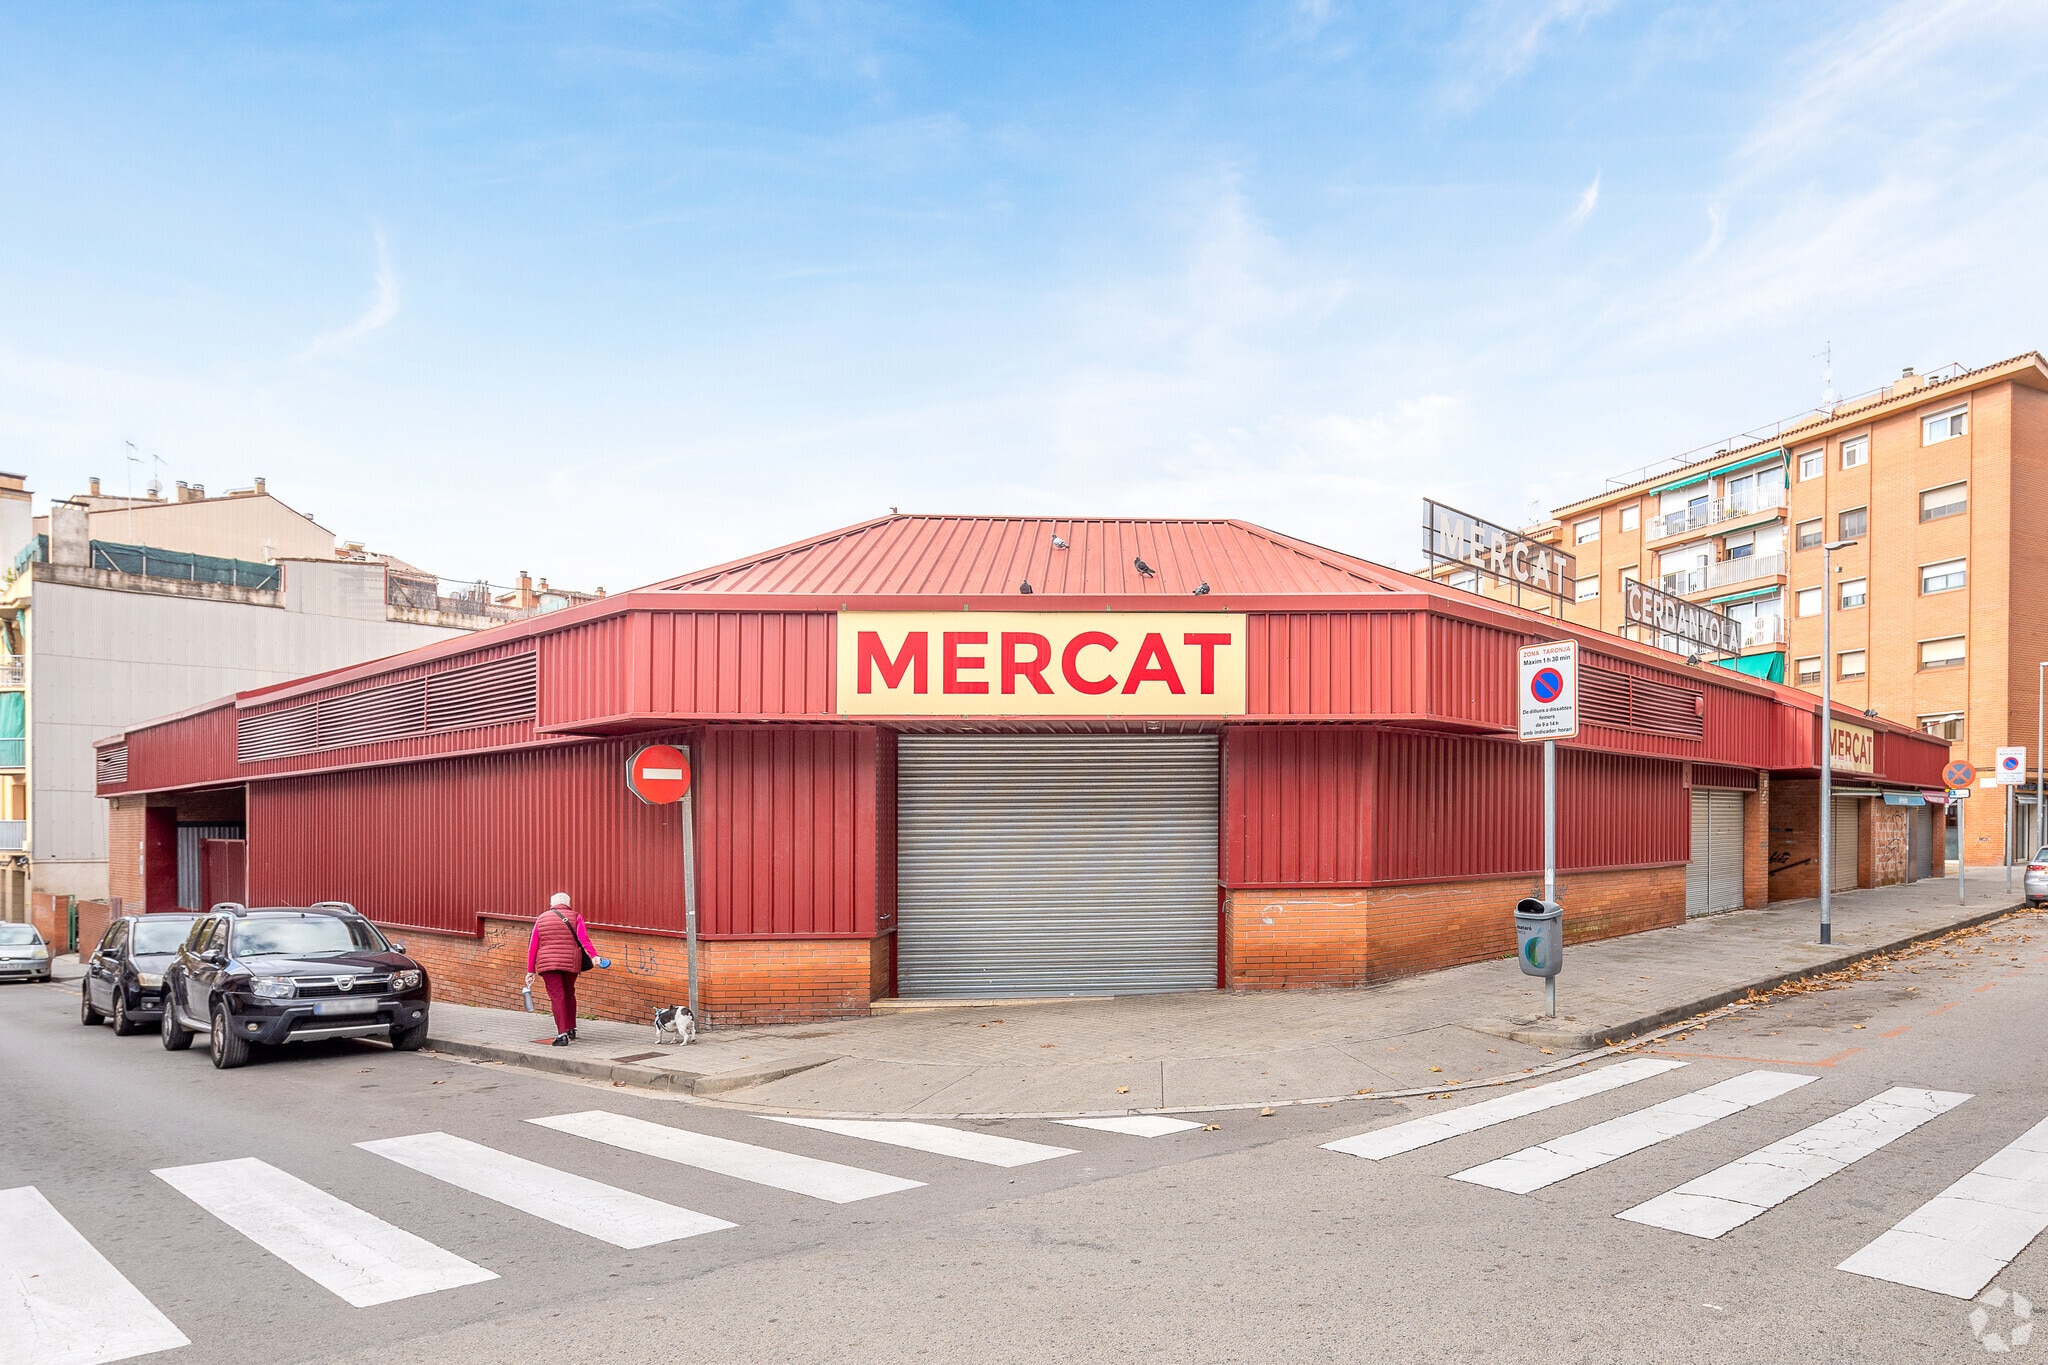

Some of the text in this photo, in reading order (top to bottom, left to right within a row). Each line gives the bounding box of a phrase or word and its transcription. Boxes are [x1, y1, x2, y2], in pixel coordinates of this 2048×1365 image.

[1440, 512, 1567, 594] MERCAT
[1630, 586, 1739, 653] CERDANYOLA
[857, 631, 1232, 695] MERCAT
[1523, 646, 1571, 658] ZONA TARONJA
[1830, 728, 1872, 765] MERCAT
